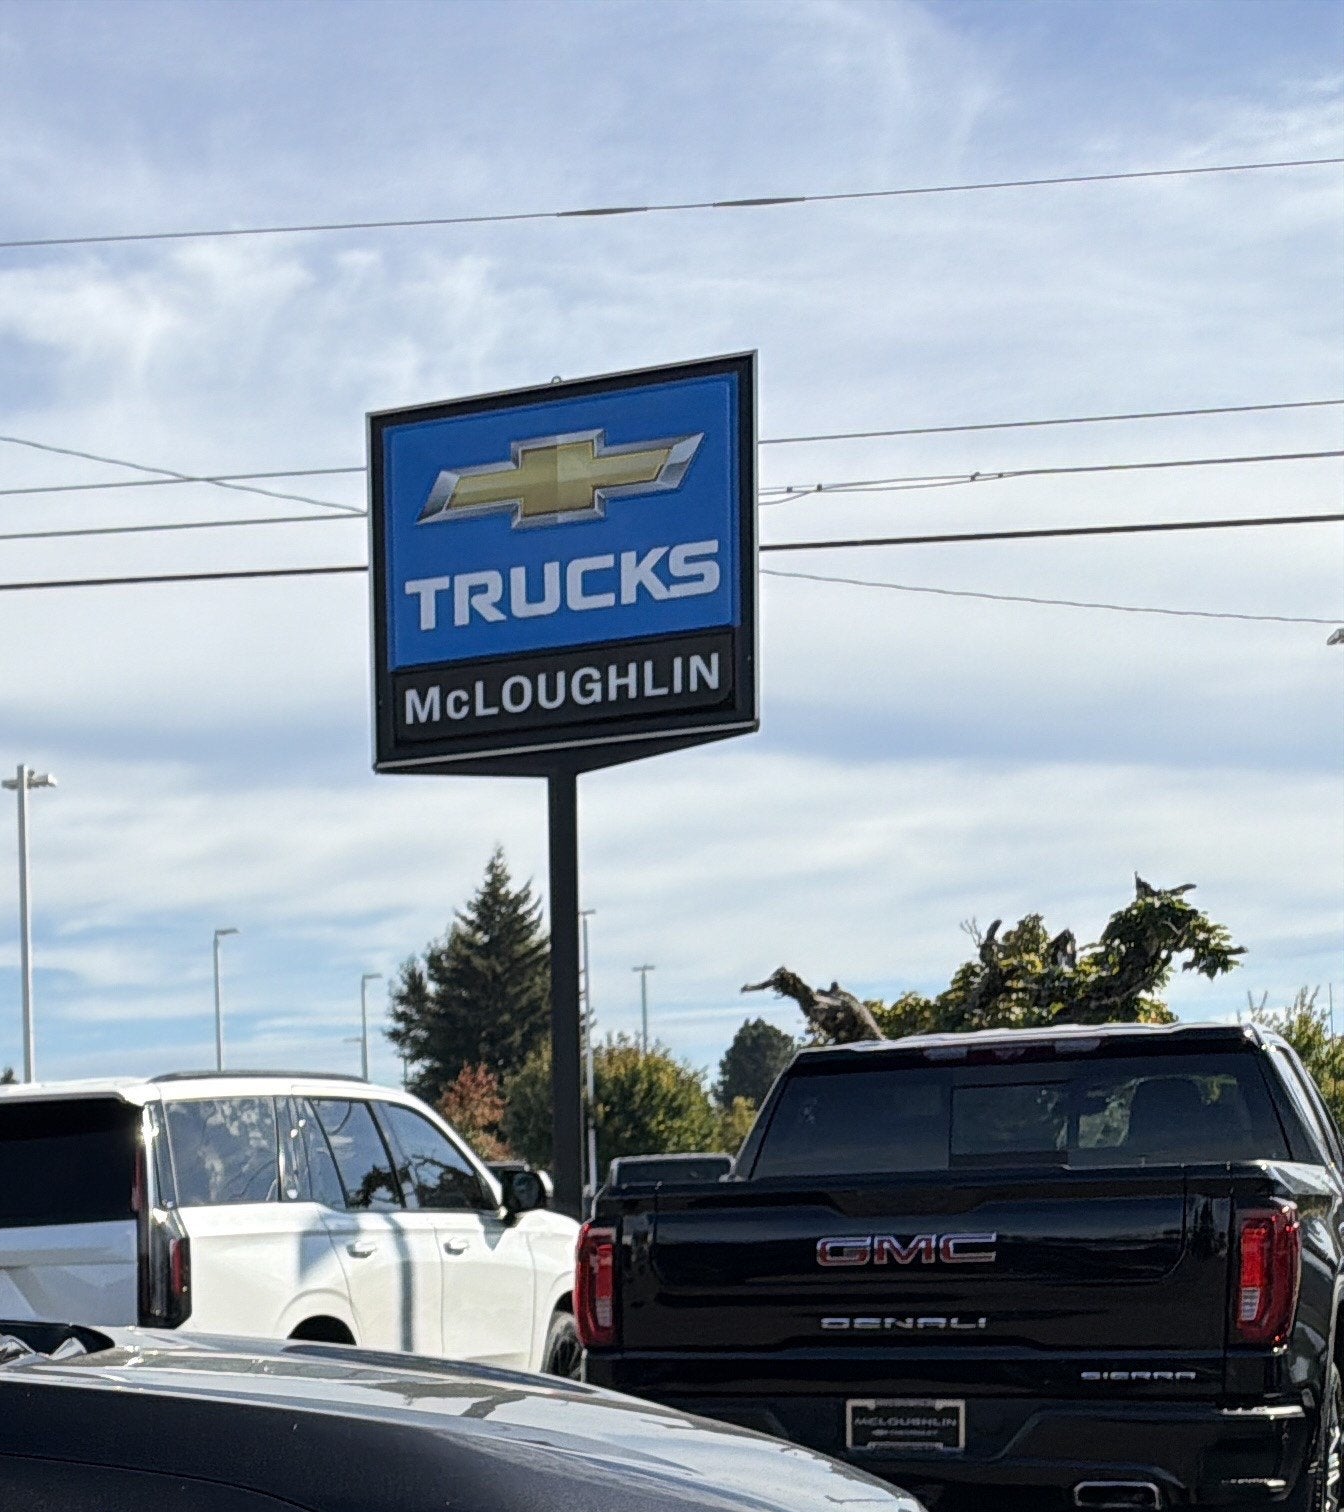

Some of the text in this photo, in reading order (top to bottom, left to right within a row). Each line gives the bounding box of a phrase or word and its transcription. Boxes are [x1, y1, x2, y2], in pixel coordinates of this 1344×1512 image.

[405, 539, 719, 631] TRUCKS
[405, 652, 719, 725] McLOUGHLIN
[816, 1231, 997, 1267] GMC
[820, 1317, 987, 1329] DENALI
[1080, 1371, 1197, 1380] SIERRA
